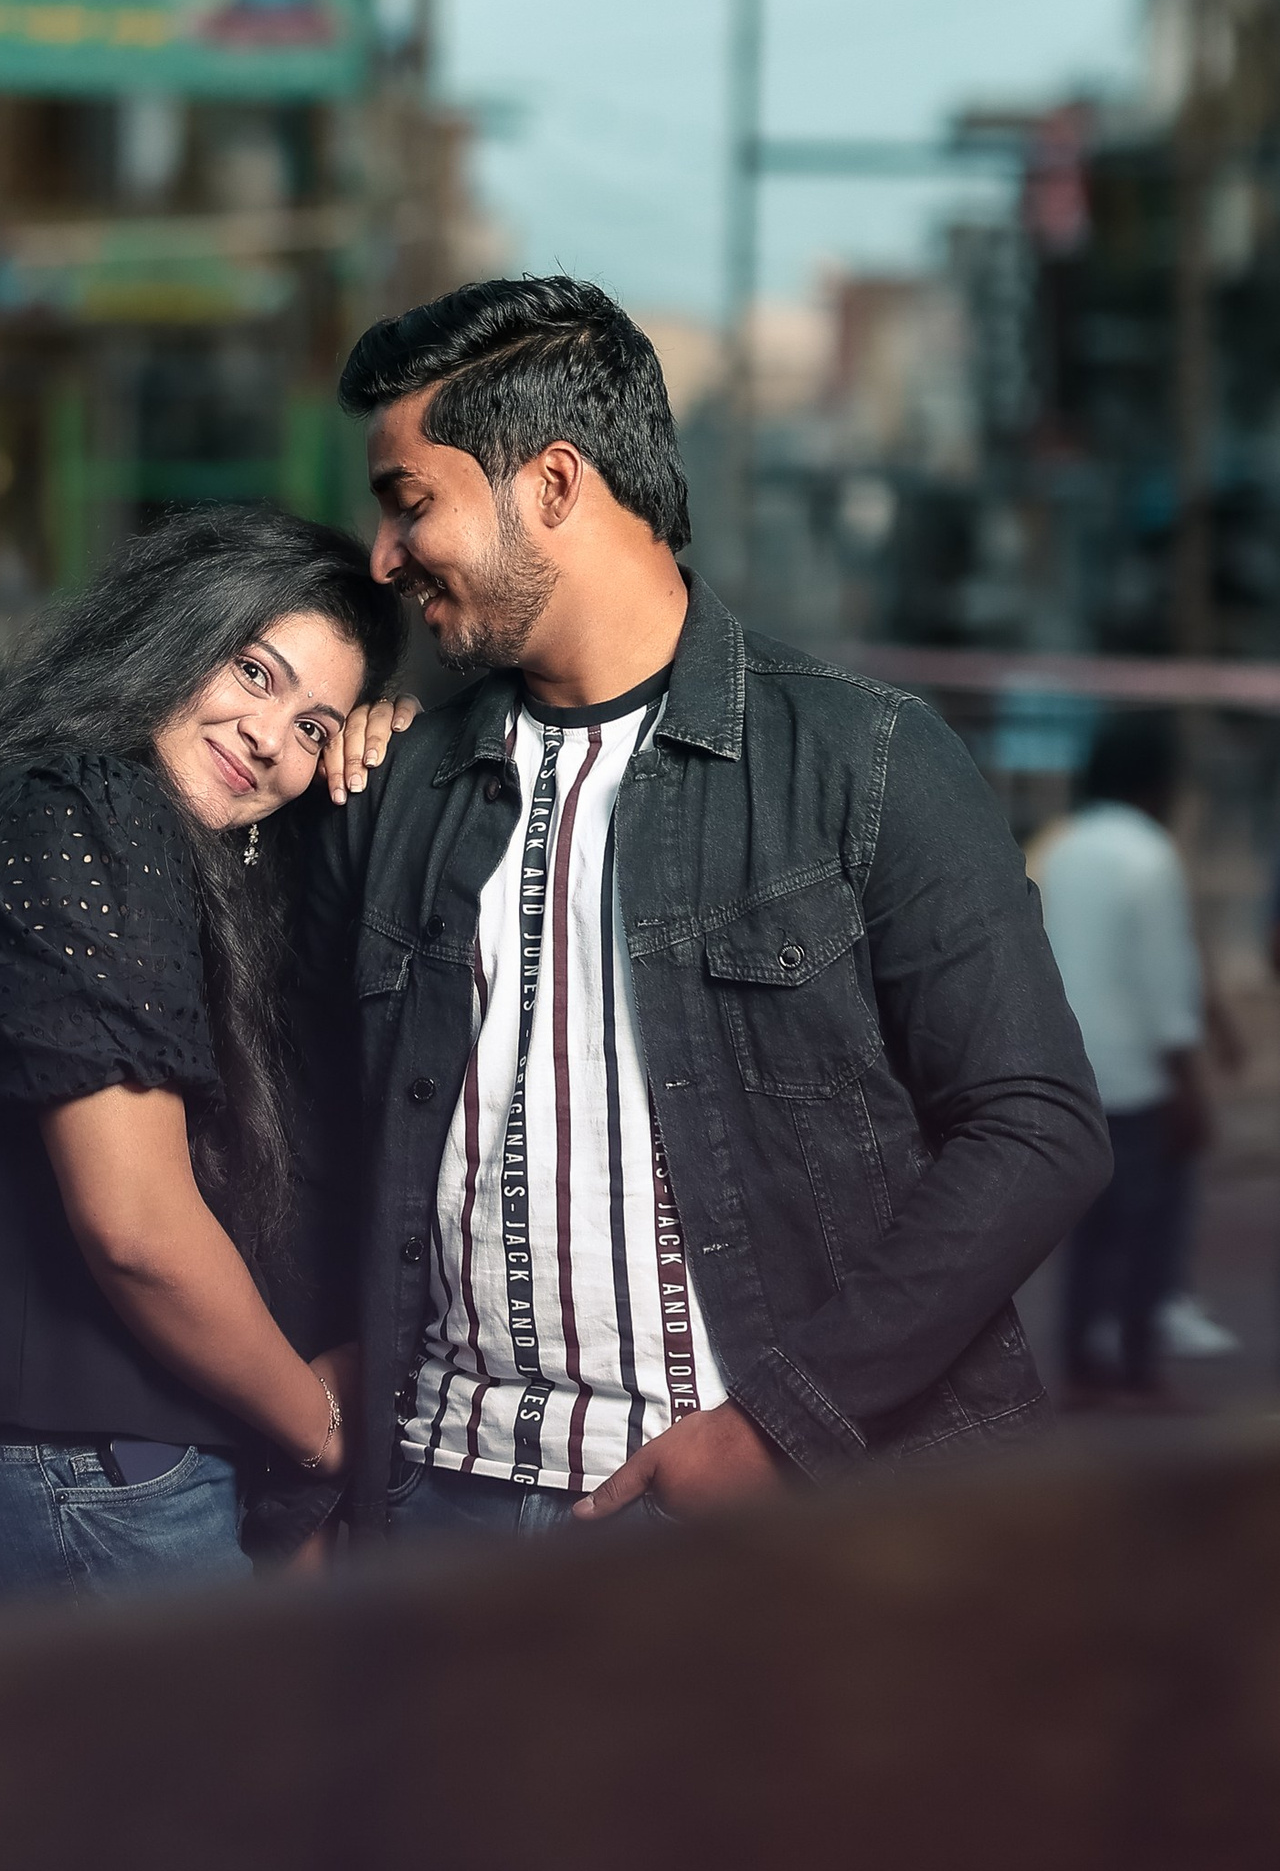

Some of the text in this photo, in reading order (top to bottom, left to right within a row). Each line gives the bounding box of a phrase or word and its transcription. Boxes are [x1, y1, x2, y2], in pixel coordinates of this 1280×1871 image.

[522, 867, 545, 916] AND
[510, 1299, 536, 1348] AND
[662, 1283, 688, 1333] AND
[519, 1365, 551, 1421] JES
[668, 1351, 697, 1423] JONE
